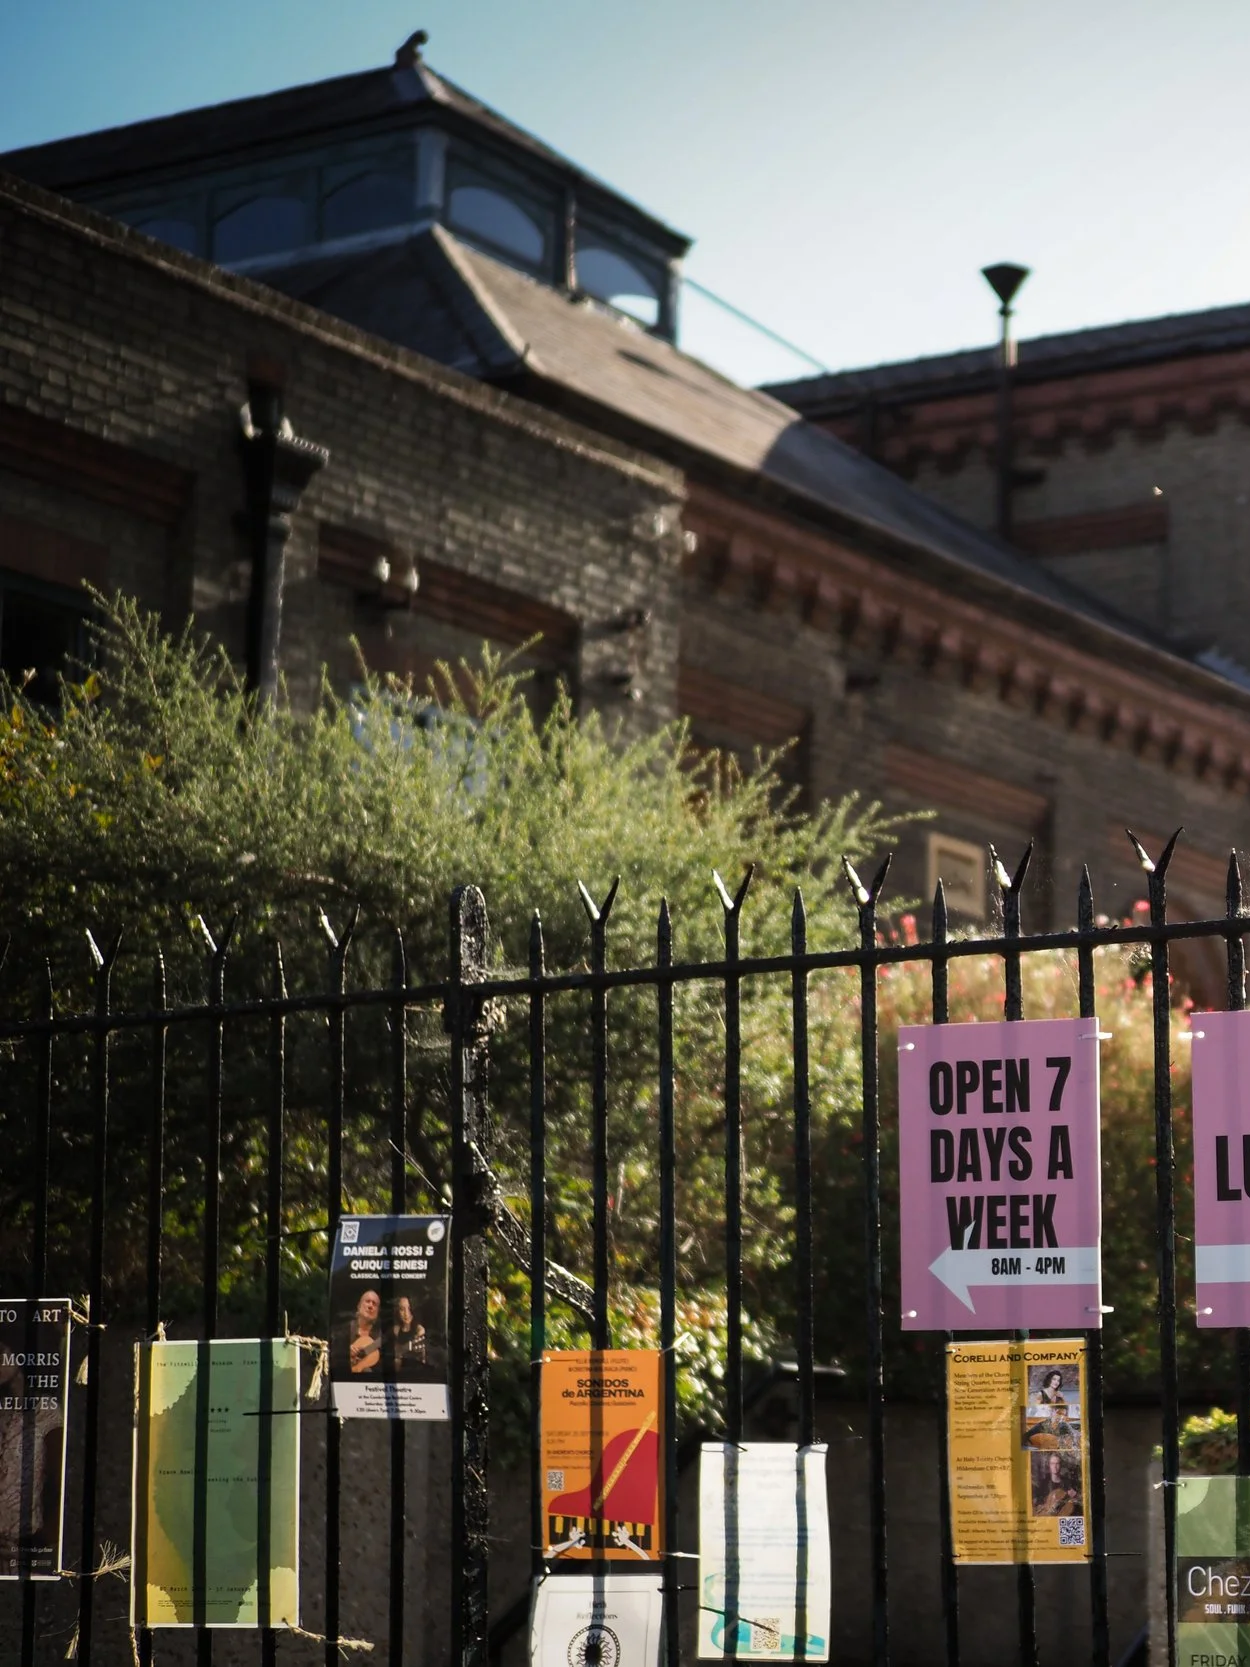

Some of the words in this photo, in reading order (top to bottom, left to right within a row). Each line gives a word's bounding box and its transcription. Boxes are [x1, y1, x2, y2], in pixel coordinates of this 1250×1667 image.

[929, 1058, 1030, 1115] OPEN
[1046, 1056, 1071, 1111] 7
[930, 1126, 1033, 1183] DAYS
[1048, 1125, 1073, 1180] A
[946, 1194, 1059, 1250] WEEK
[343, 1246, 388, 1256] DANIELA
[391, 1246, 423, 1256] ROSSI
[425, 1246, 434, 1256] &
[351, 1259, 390, 1271] QUIQUE
[393, 1259, 428, 1271] SINESI
[991, 1257, 1021, 1275] 8AM
[1035, 1256, 1065, 1274] 4PM
[32, 1309, 61, 1322] ART
[2, 1353, 60, 1366] MORRIS
[1000, 1354, 1020, 1362] AND
[1023, 1352, 1079, 1361] COMPANY
[27, 1375, 59, 1388] THE
[577, 1379, 629, 1388] SONIDOS
[562, 1389, 575, 1398] de
[576, 1389, 645, 1398] ARGENTINA
[0, 1396, 58, 1410] ELITES
[1191, 1654, 1247, 1667] FRIDAY
